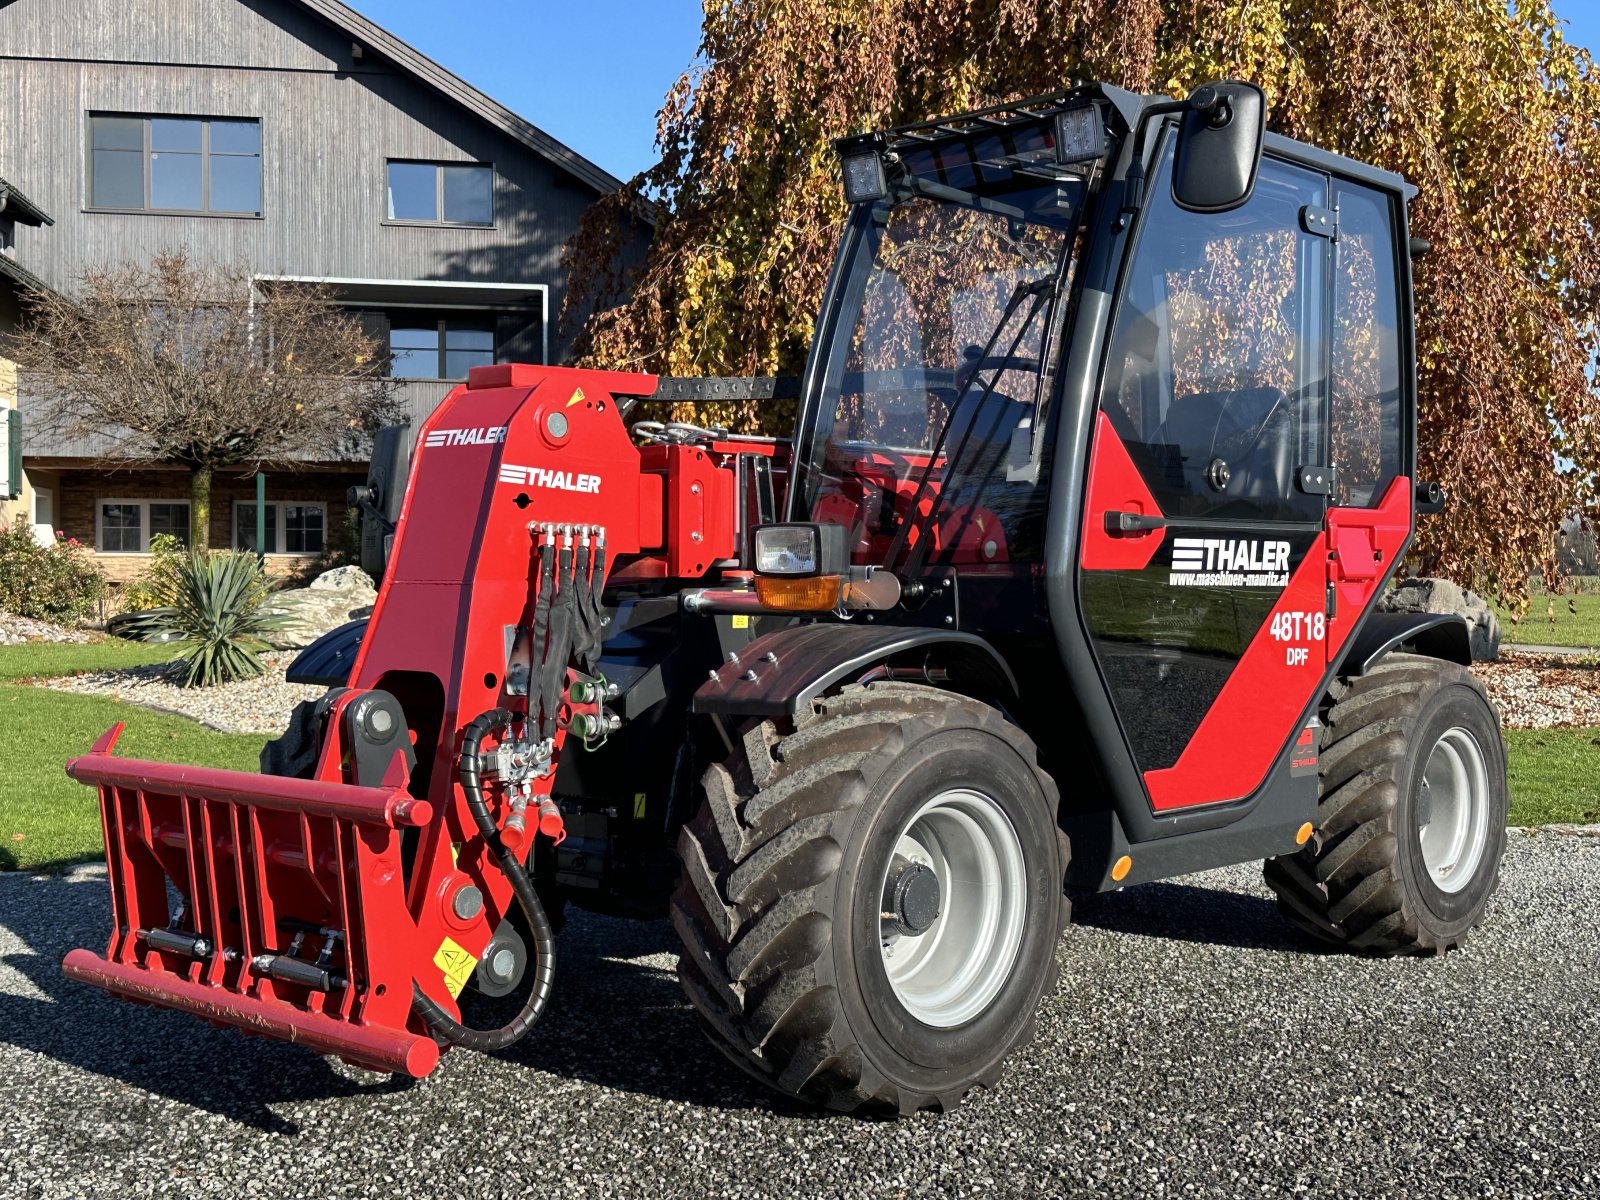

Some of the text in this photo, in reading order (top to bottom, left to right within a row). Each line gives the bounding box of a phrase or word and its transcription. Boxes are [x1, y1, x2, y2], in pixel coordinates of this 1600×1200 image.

[445, 426, 508, 446] THALER
[525, 467, 602, 494] THALER
[1203, 539, 1291, 570] THALER
[1169, 571, 1290, 587] www.maschinen-mauritz.at
[1270, 611, 1325, 641] 48T18
[1286, 647, 1309, 666] DPF
